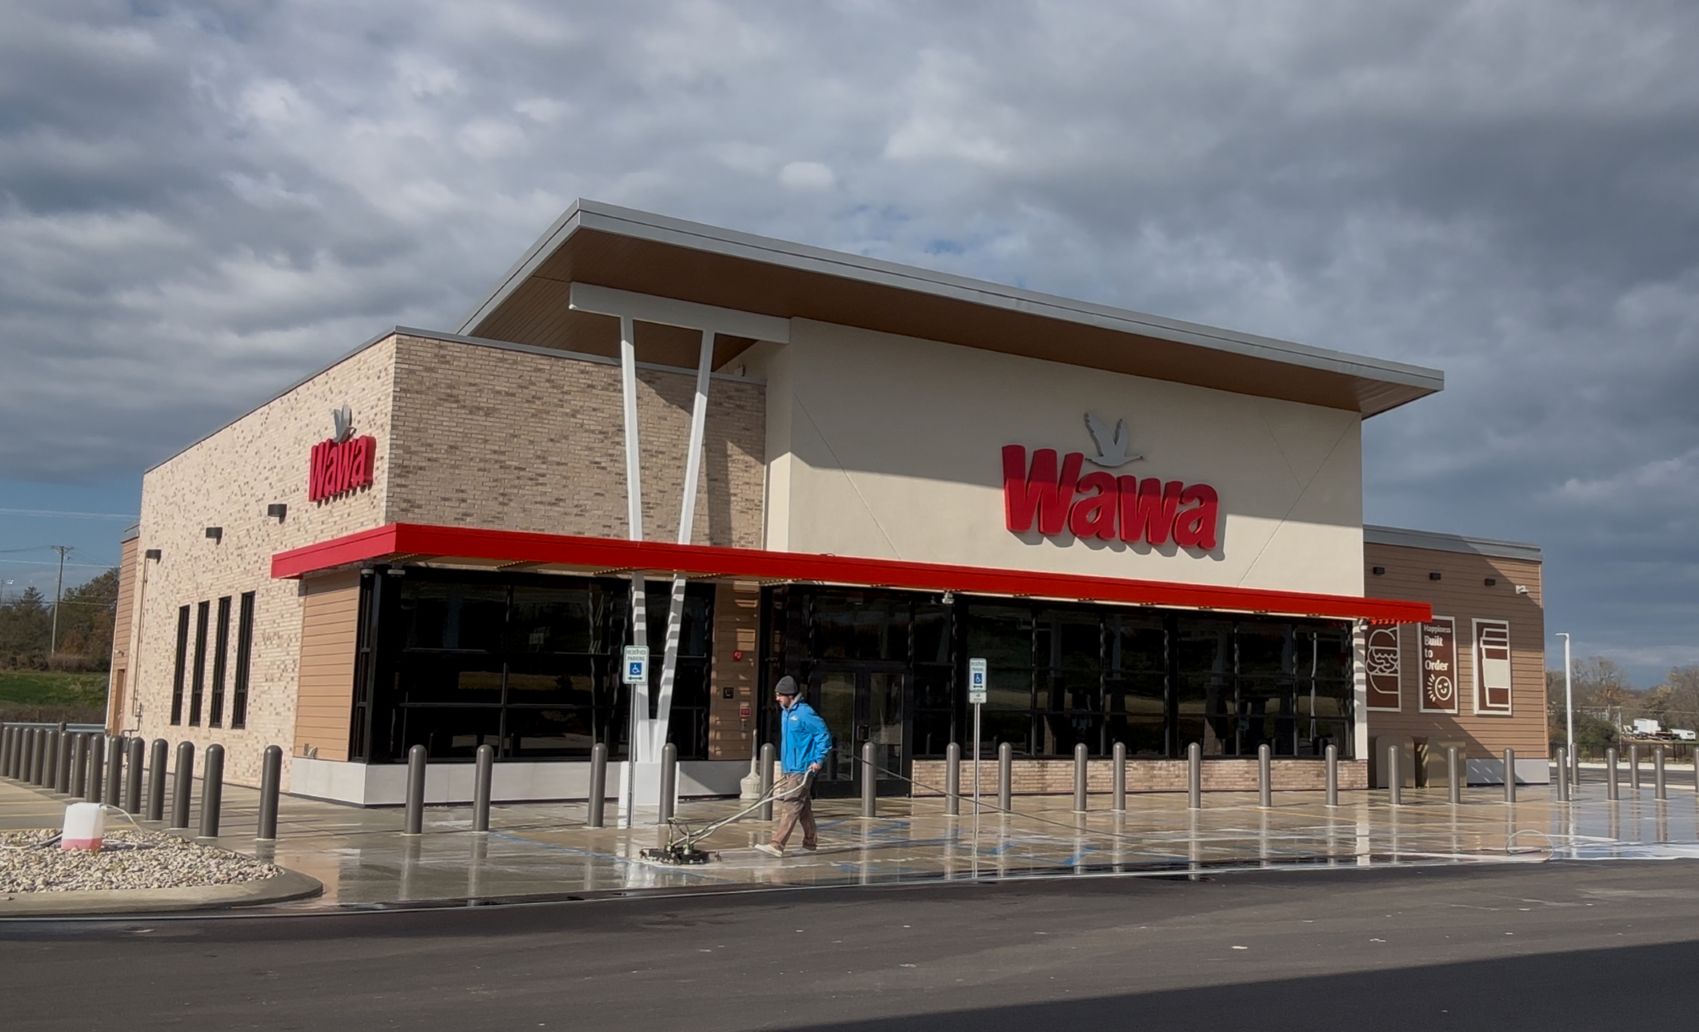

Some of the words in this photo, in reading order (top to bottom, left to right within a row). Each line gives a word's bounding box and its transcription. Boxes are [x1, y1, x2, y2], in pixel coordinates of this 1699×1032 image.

[309, 435, 376, 502] Wawa
[1002, 444, 1218, 550] Wawa
[1424, 635, 1443, 646] Built
[1424, 648, 1433, 658] to
[1424, 660, 1448, 671] Order
